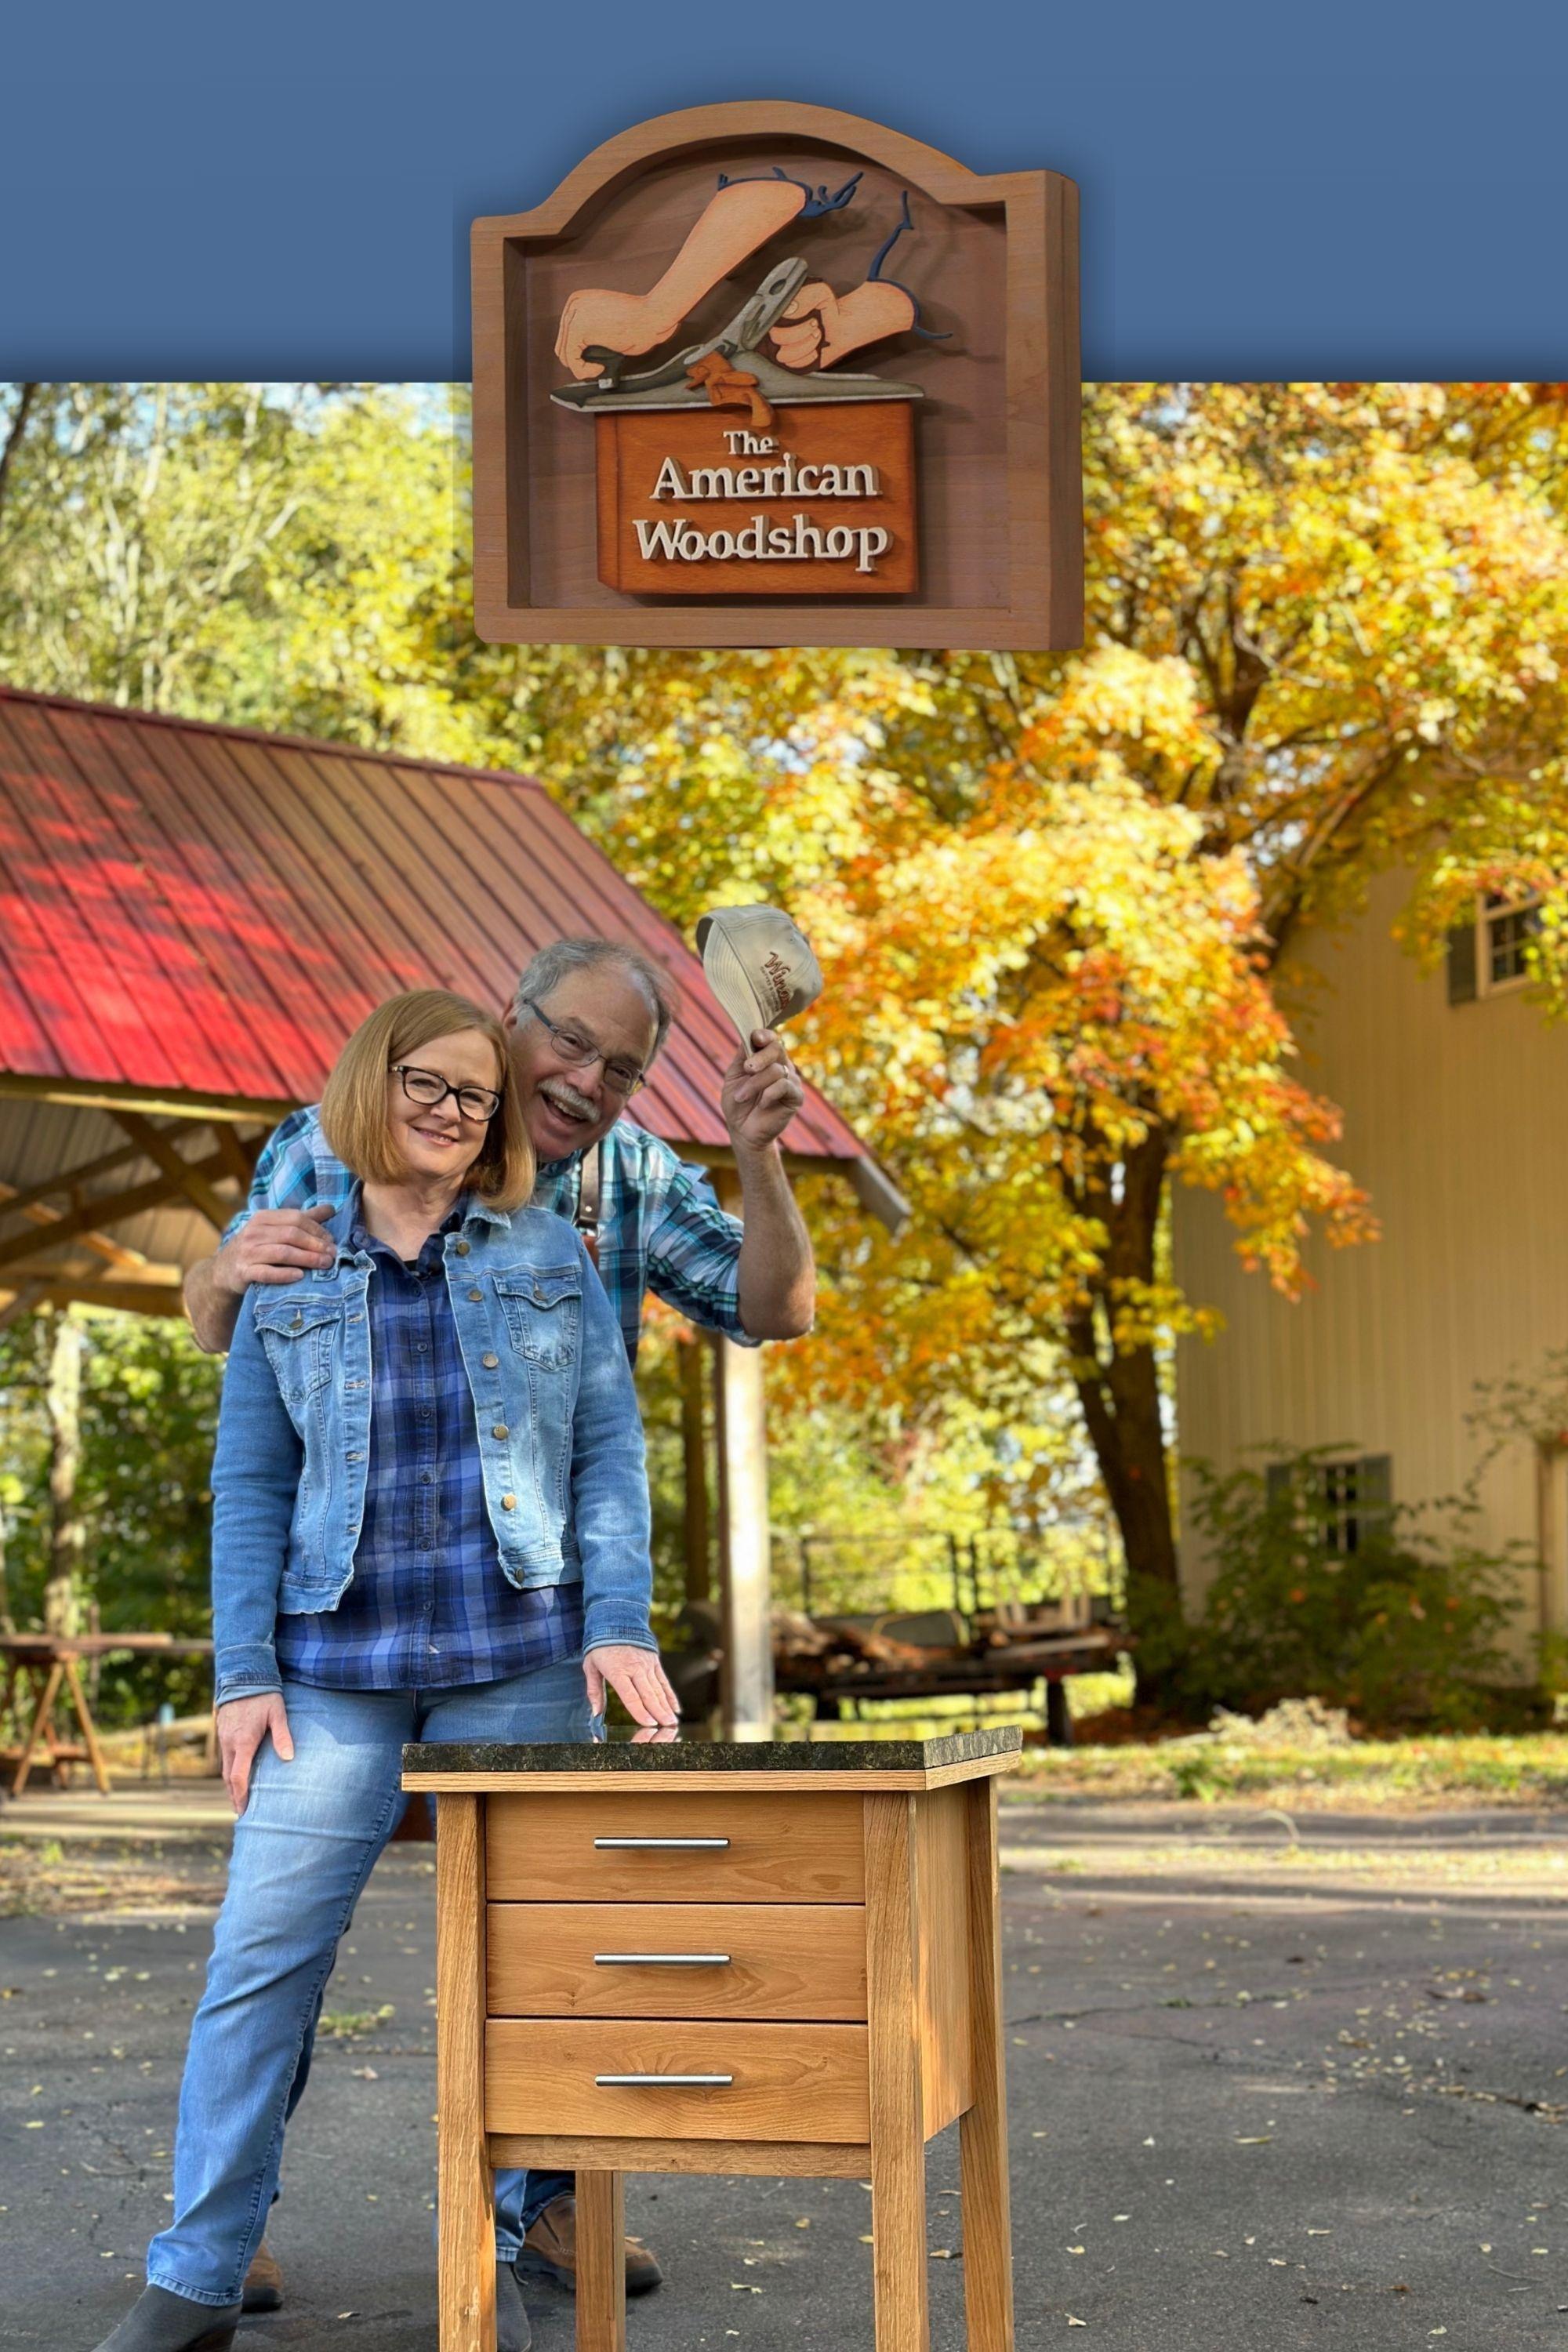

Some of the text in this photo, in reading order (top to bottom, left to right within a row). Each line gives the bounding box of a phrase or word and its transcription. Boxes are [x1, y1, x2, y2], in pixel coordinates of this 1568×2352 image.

[723, 430, 778, 455] The
[649, 452, 882, 499] American
[632, 514, 891, 572] Woodshop
